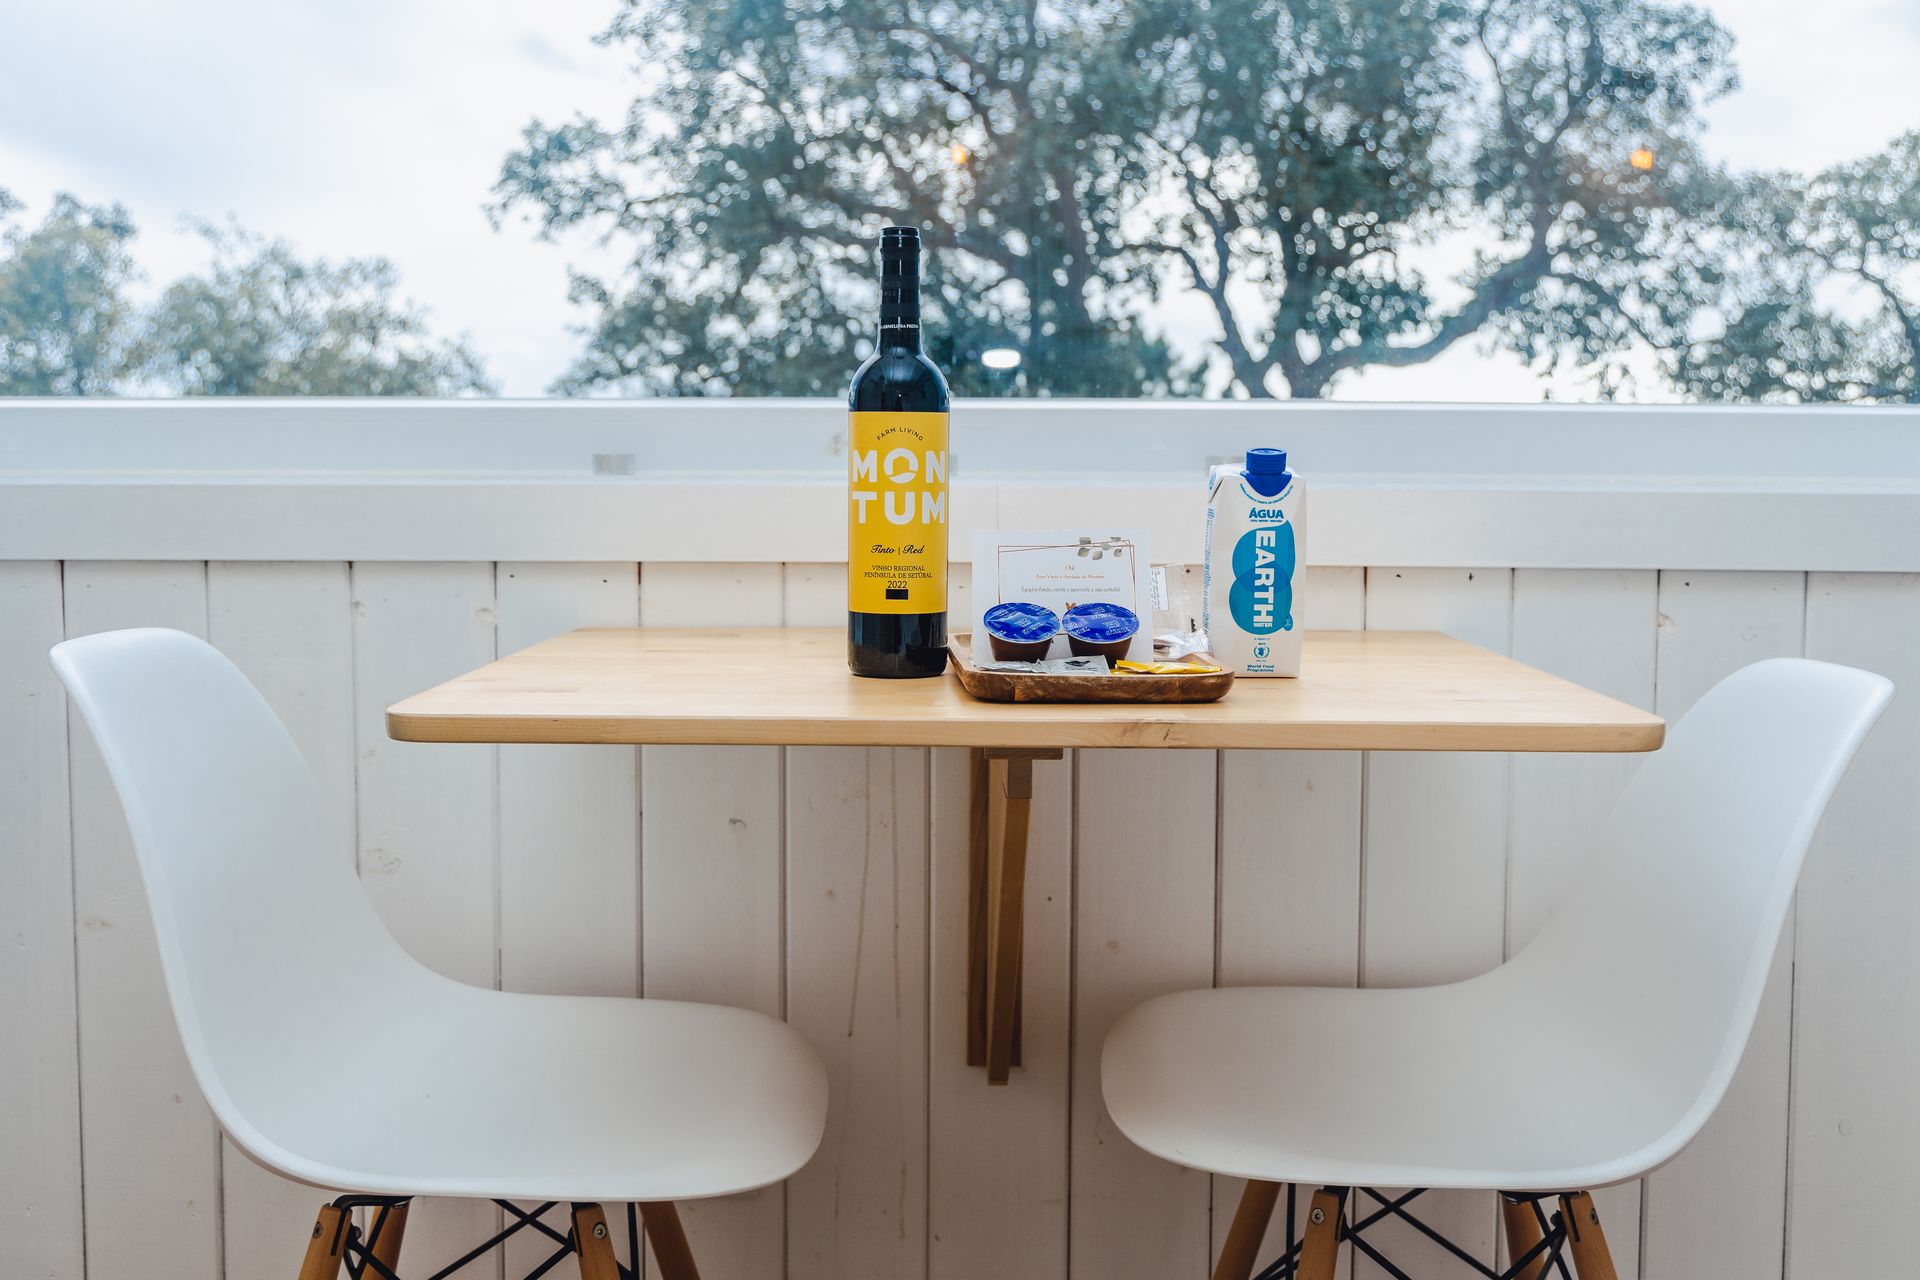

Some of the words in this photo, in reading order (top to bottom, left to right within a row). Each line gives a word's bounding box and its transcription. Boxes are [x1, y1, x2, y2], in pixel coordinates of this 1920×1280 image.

[876, 427, 897, 441] FARM
[899, 426, 924, 442] LIVING
[852, 447, 945, 484] MON
[852, 491, 945, 525] TUM
[1249, 507, 1285, 519] ÁGUA
[871, 544, 895, 554] Tinto
[902, 544, 926, 554] Red
[864, 571, 897, 579] PENÍNSULA
[907, 571, 933, 579] SETÚBAL
[1253, 530, 1276, 622] EARTH
[887, 580, 908, 589] 2022
